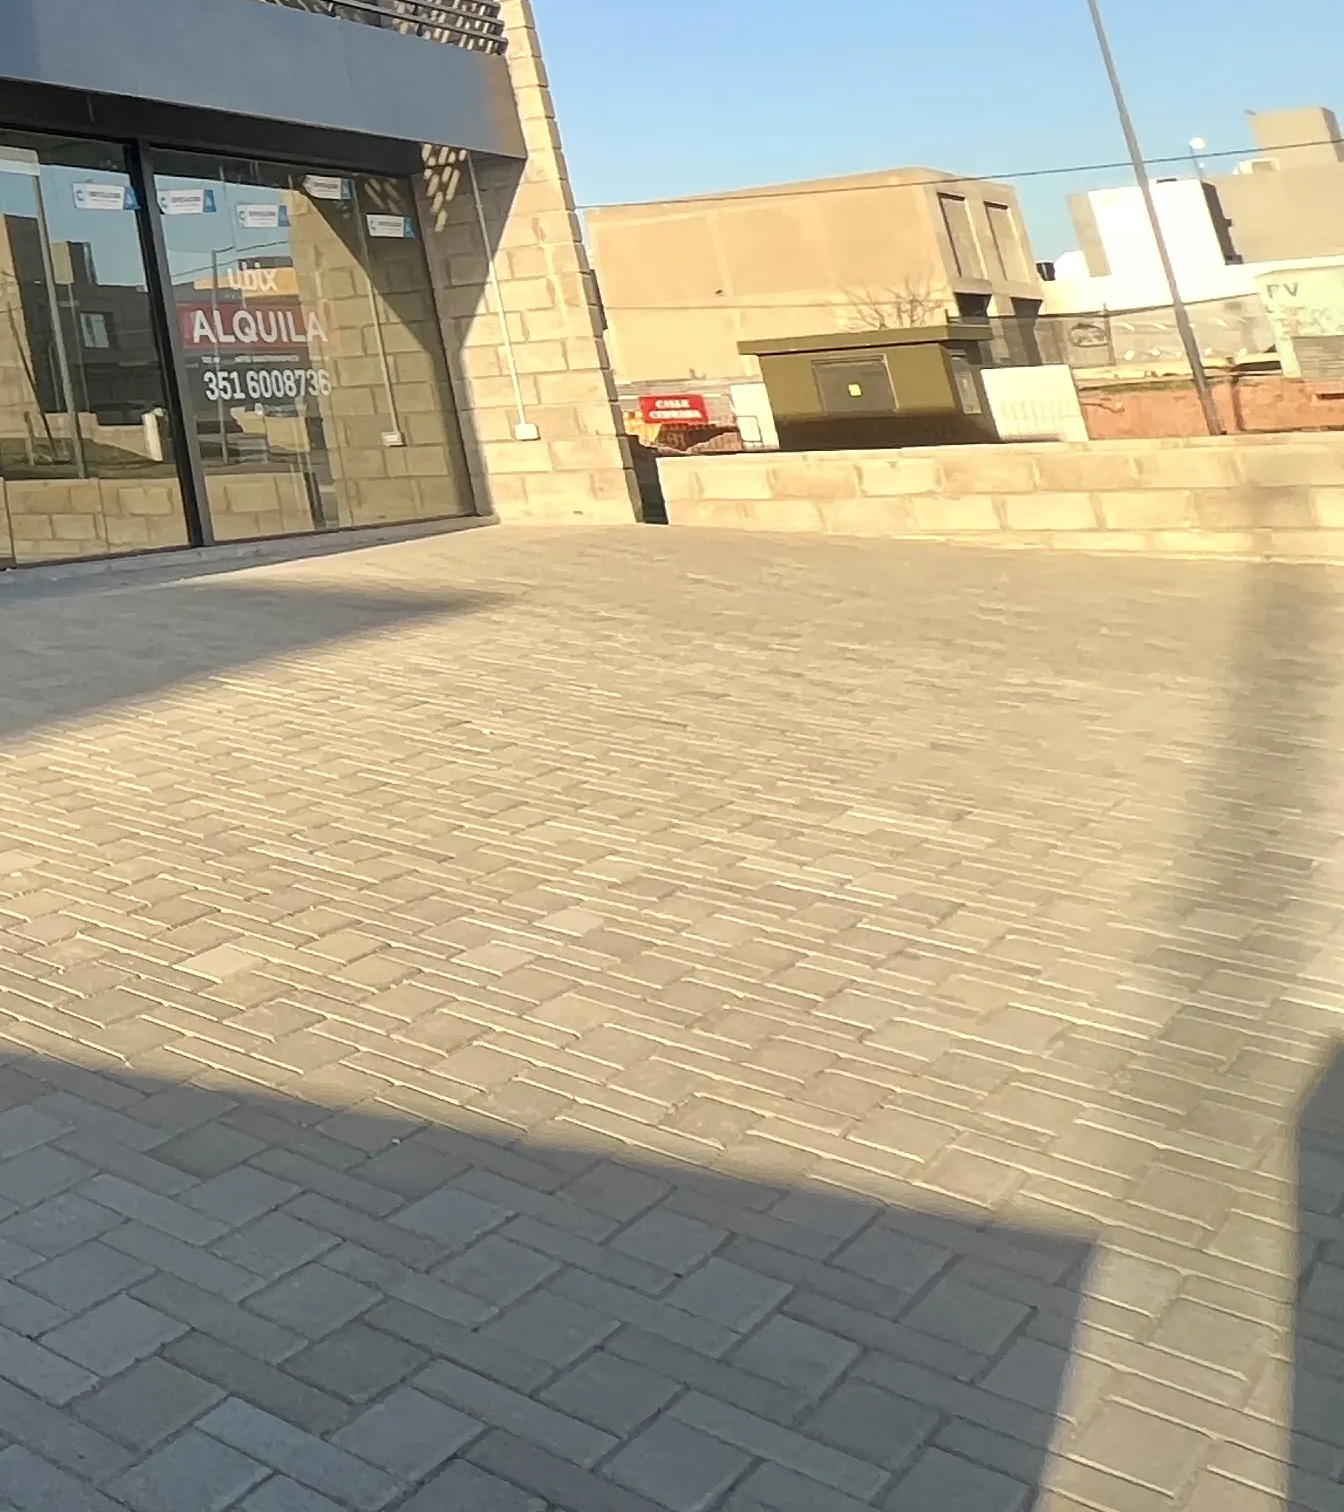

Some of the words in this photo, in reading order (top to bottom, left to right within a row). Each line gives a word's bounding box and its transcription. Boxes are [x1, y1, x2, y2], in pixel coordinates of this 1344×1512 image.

[227, 261, 278, 292] ubix
[193, 310, 329, 343] ALQUILA
[203, 370, 246, 401] 351
[246, 368, 332, 399] 6008736
